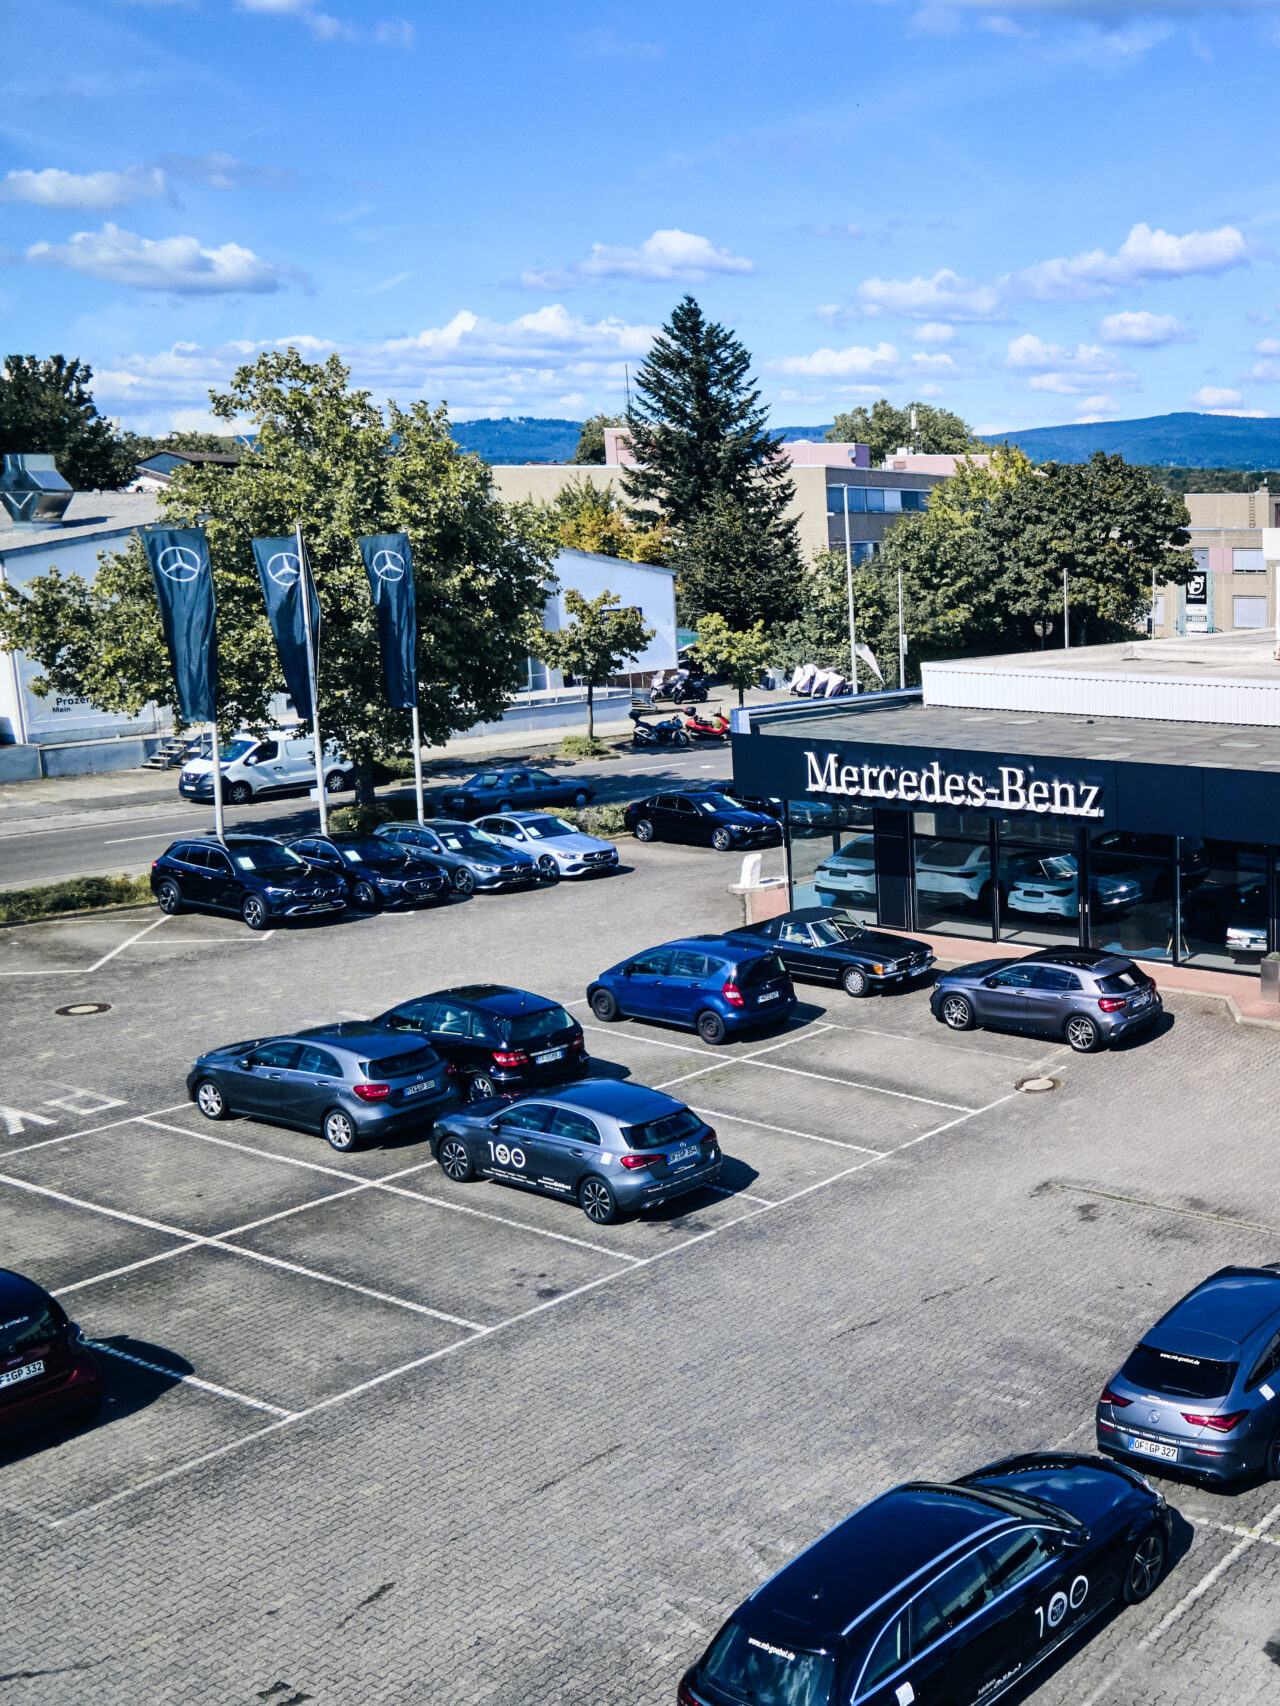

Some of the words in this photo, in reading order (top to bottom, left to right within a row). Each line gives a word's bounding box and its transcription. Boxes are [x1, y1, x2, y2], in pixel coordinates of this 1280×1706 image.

[55, 697, 93, 706] Prozen
[803, 751, 1104, 817] Mercedes-Benz
[487, 1141, 526, 1169] 100
[11, 1368, 24, 1380] GP
[25, 1361, 43, 1375] 332
[1134, 1439, 1144, 1450] OF
[1149, 1443, 1160, 1454] GP
[1161, 1446, 1177, 1458] 327
[1034, 1574, 1090, 1639] 100
